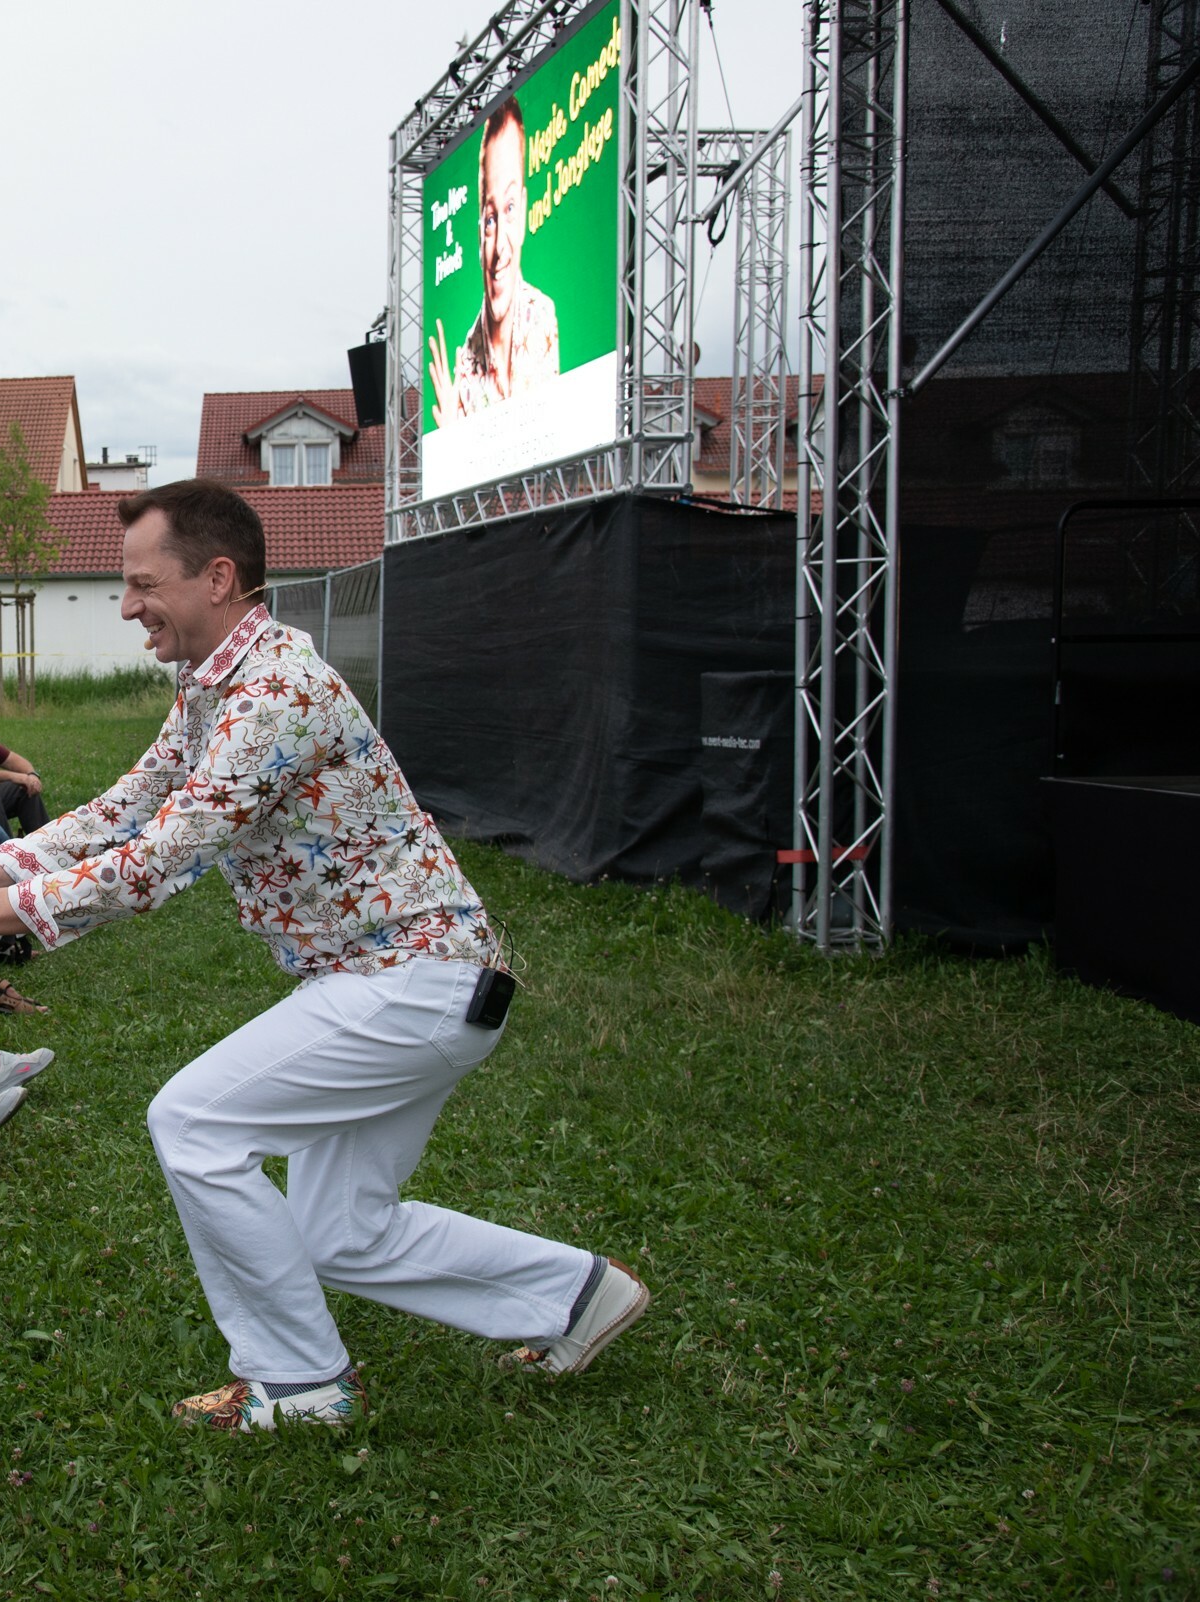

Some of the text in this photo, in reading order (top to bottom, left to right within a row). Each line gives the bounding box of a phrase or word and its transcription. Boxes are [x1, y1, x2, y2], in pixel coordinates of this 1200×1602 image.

[528, 107, 613, 235] und Jonglage
[435, 241, 463, 287] Friends
